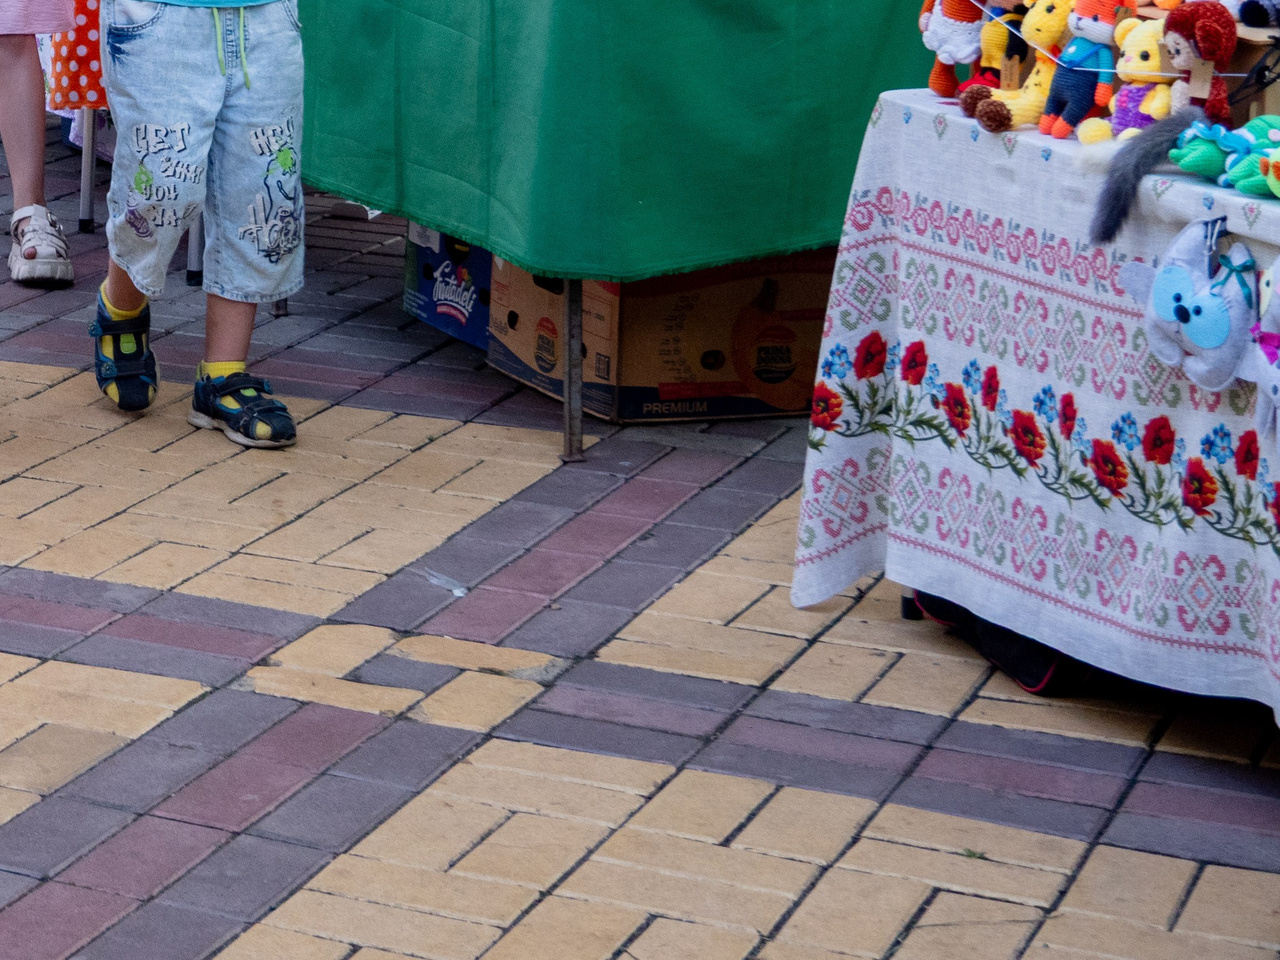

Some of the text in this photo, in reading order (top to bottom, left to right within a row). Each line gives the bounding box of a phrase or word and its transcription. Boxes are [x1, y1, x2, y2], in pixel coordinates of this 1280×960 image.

[132, 122, 191, 155] GET
[757, 345, 791, 356] PRIMA
[642, 401, 708, 414] PREMIUM
